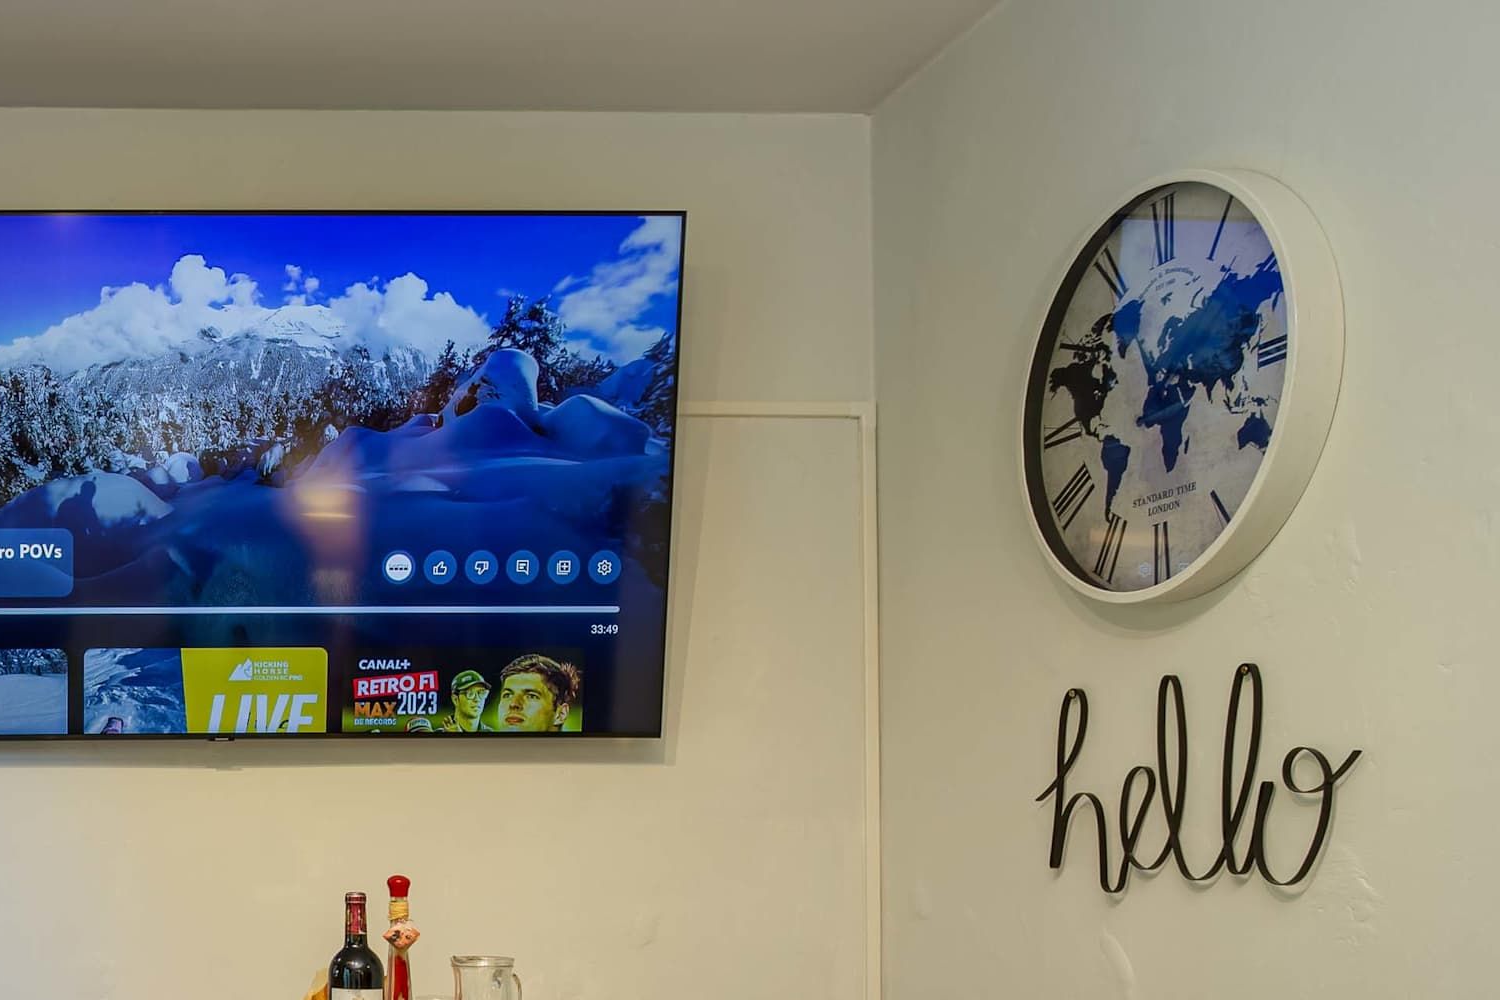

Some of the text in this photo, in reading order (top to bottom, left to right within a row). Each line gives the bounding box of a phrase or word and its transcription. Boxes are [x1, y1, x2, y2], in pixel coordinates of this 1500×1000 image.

[1132, 481, 1197, 508] STANDARD TIME
[1147, 500, 1181, 516] LONDON
[20, 543, 63, 559] POVs
[590, 624, 619, 634] 33:49
[358, 659, 411, 670] CANAL+
[357, 673, 435, 696] RETRO F1
[354, 701, 397, 717] MAX
[396, 691, 438, 715] 2023
[1036, 663, 1363, 893] hello
